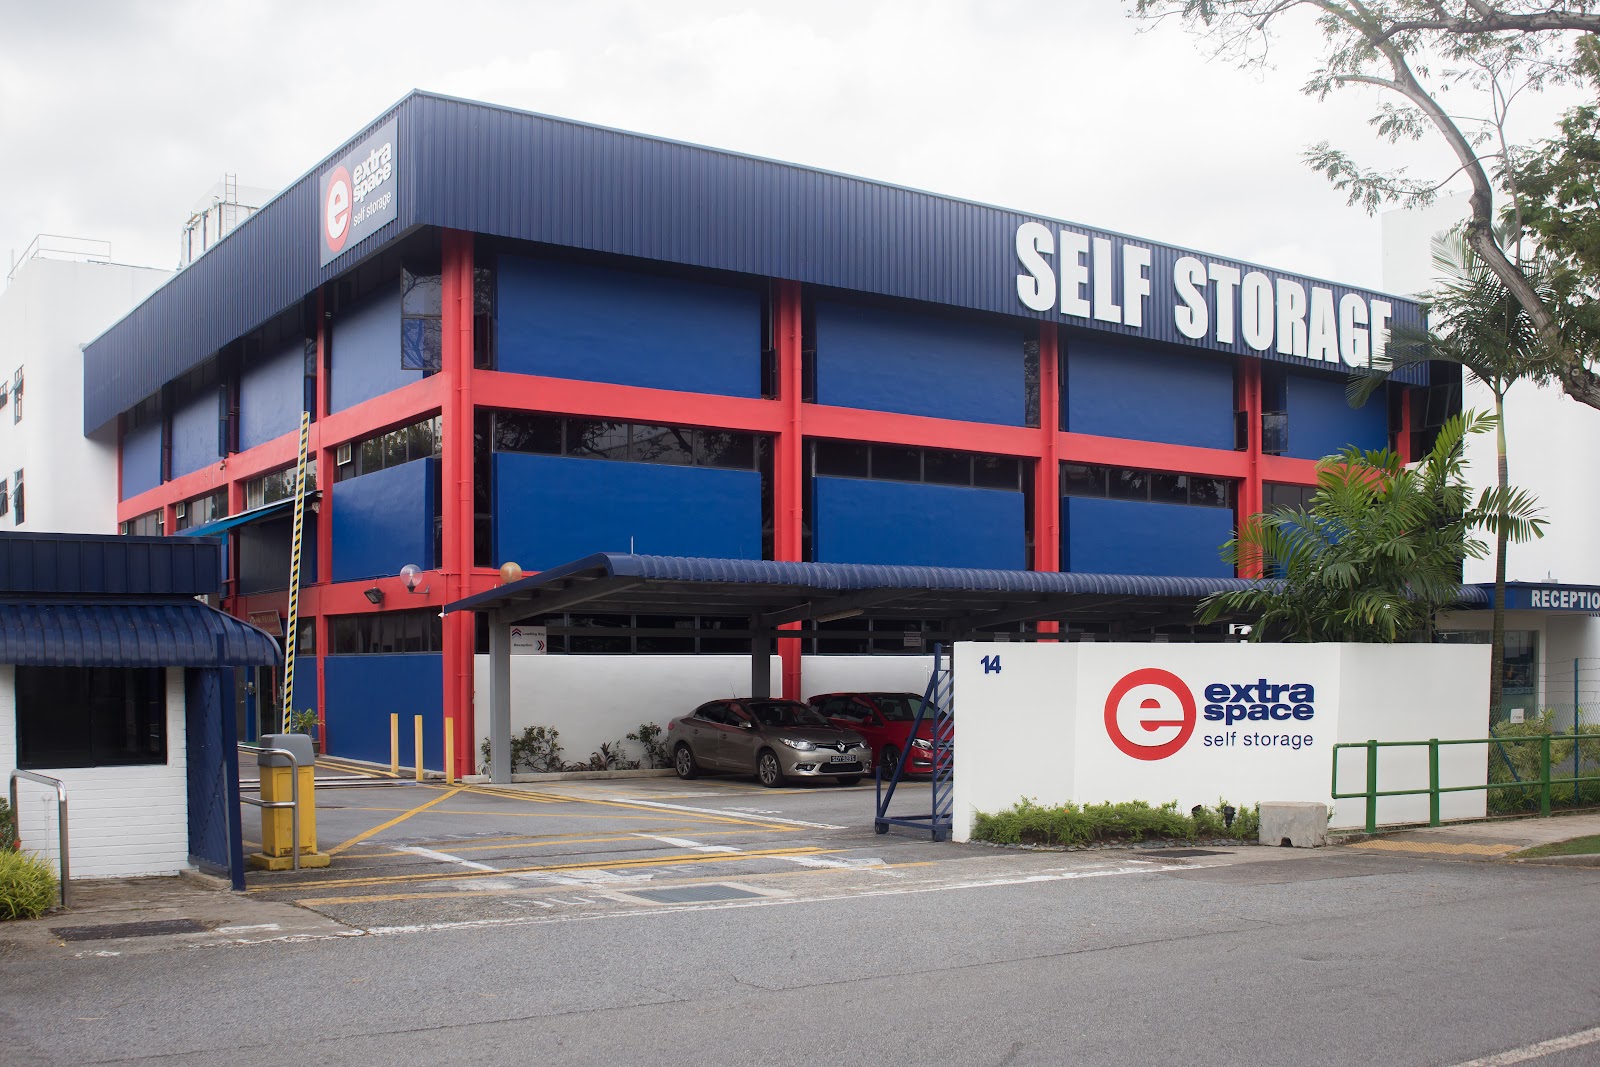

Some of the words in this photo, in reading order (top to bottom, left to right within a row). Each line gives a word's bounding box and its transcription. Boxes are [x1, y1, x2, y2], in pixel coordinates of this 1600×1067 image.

[353, 142, 392, 185] extra
[353, 162, 392, 202] space
[353, 205, 366, 226] self
[366, 191, 392, 218] storage
[1015, 221, 1151, 329] SELF
[1173, 256, 1393, 371] STORAGE
[980, 655, 1002, 674] 14
[1203, 678, 1315, 704] extra
[1203, 702, 1315, 726] space
[1203, 731, 1237, 747] self
[1243, 732, 1314, 750] storage
